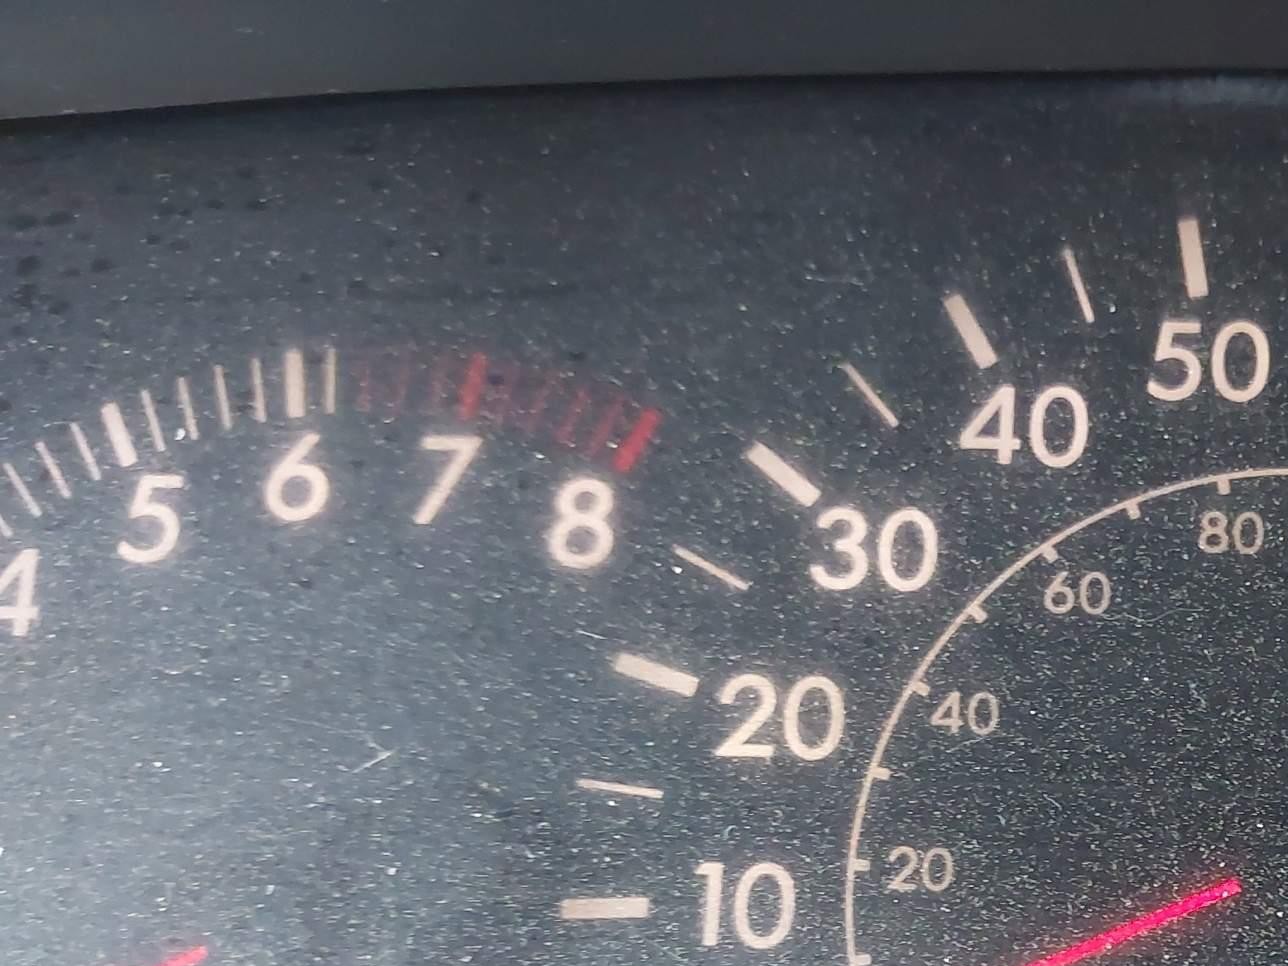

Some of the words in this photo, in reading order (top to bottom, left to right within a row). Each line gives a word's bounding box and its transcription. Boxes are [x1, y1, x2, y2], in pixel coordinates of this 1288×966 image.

[1147, 320, 1271, 402] 50
[958, 384, 1090, 468] 40
[116, 474, 184, 564] 5
[263, 432, 331, 521] 6
[415, 434, 483, 525] 7
[546, 478, 614, 568] 8
[810, 507, 939, 592] 30
[1198, 511, 1265, 555] 80
[1043, 570, 1112, 616] 60
[713, 673, 847, 762] 20
[930, 691, 1000, 736] 40
[694, 861, 797, 950] 10
[886, 845, 954, 892] 20
